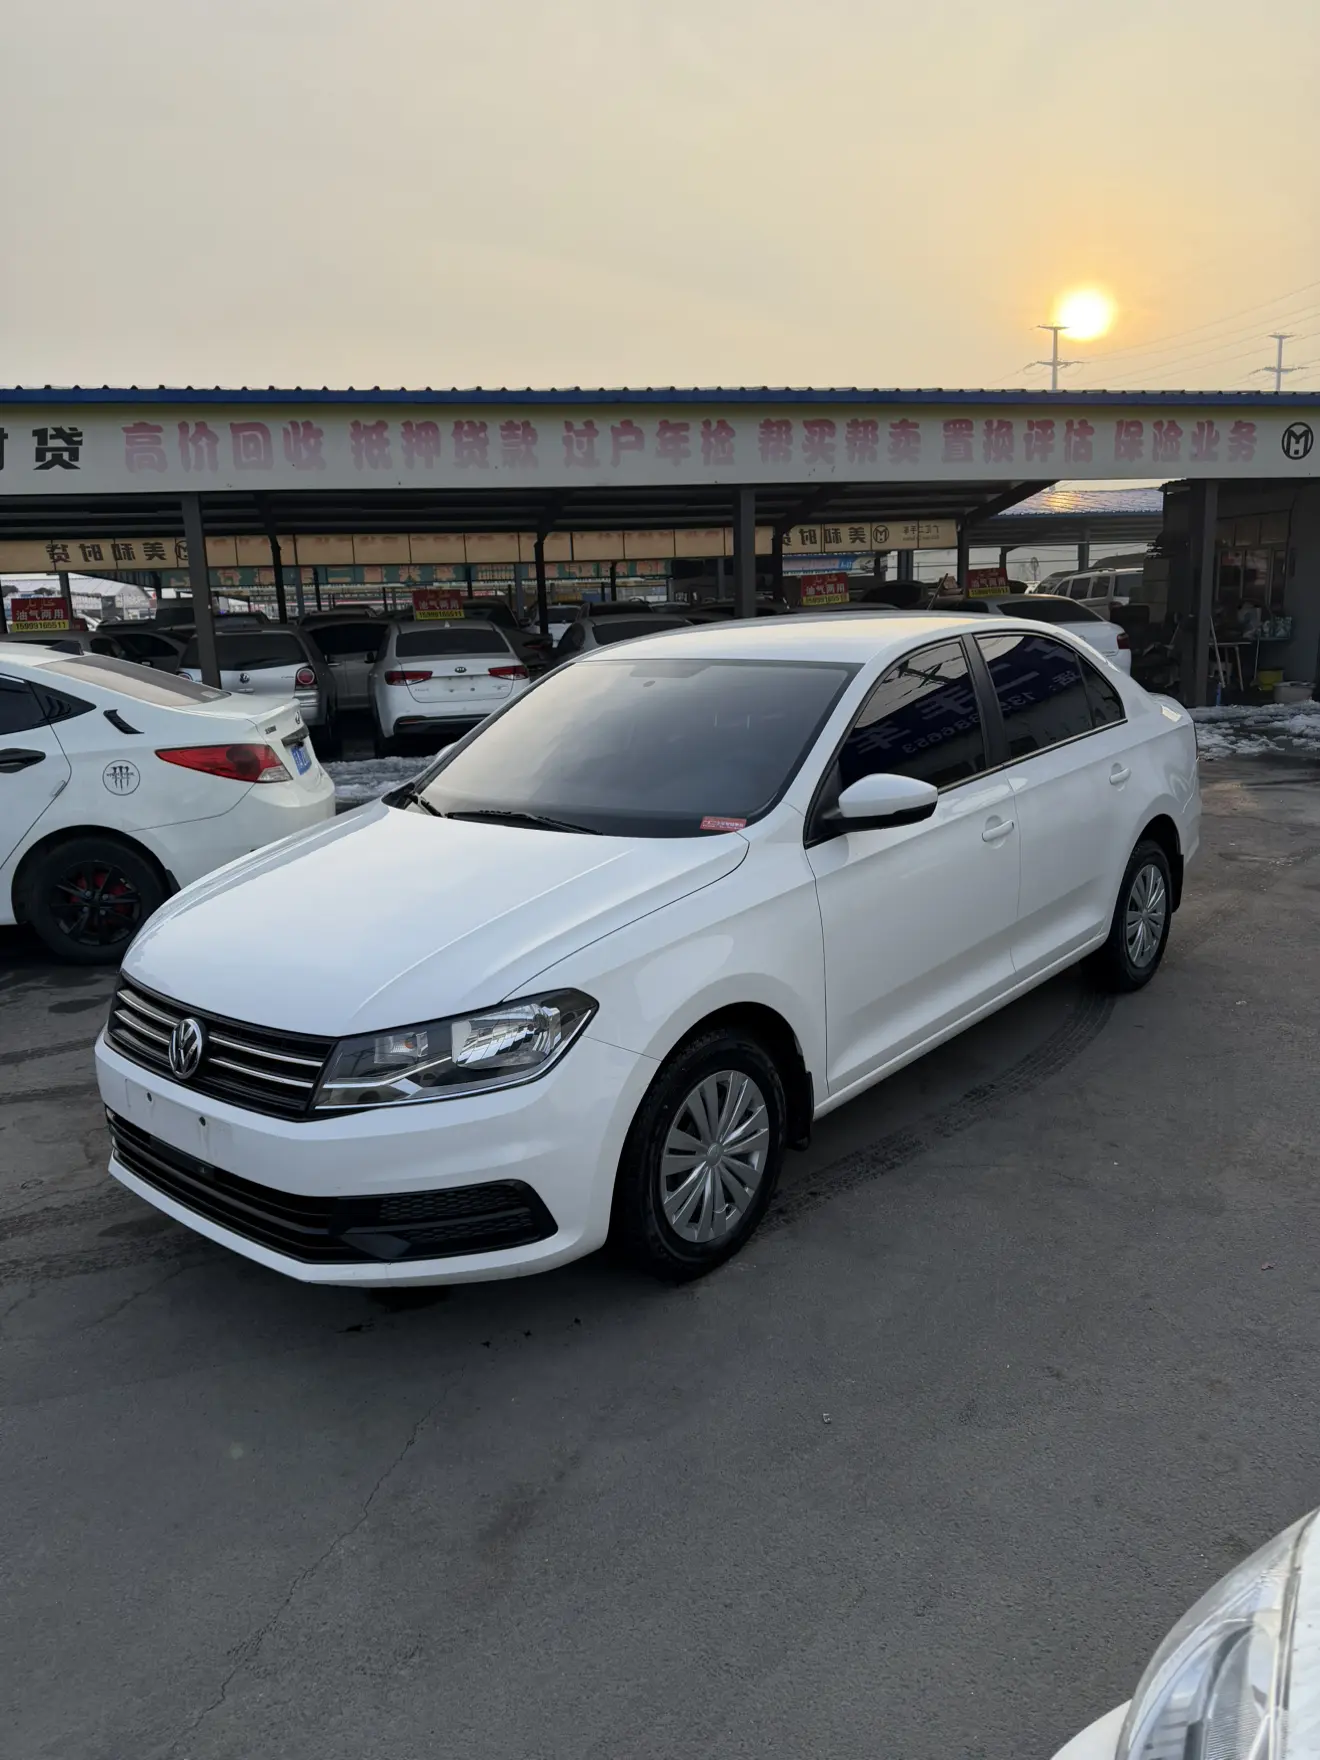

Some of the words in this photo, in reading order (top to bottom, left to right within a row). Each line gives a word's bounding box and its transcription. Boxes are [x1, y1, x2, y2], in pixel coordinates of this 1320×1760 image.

[121, 420, 327, 473] 高价回收
[350, 420, 539, 471] 抵押贷款
[563, 419, 736, 468] 过户年检
[758, 418, 922, 465] 帮买帮卖
[941, 418, 1095, 464] 置换评估
[1114, 419, 1258, 463] 保险业务
[16, 608, 64, 620] 油气两用
